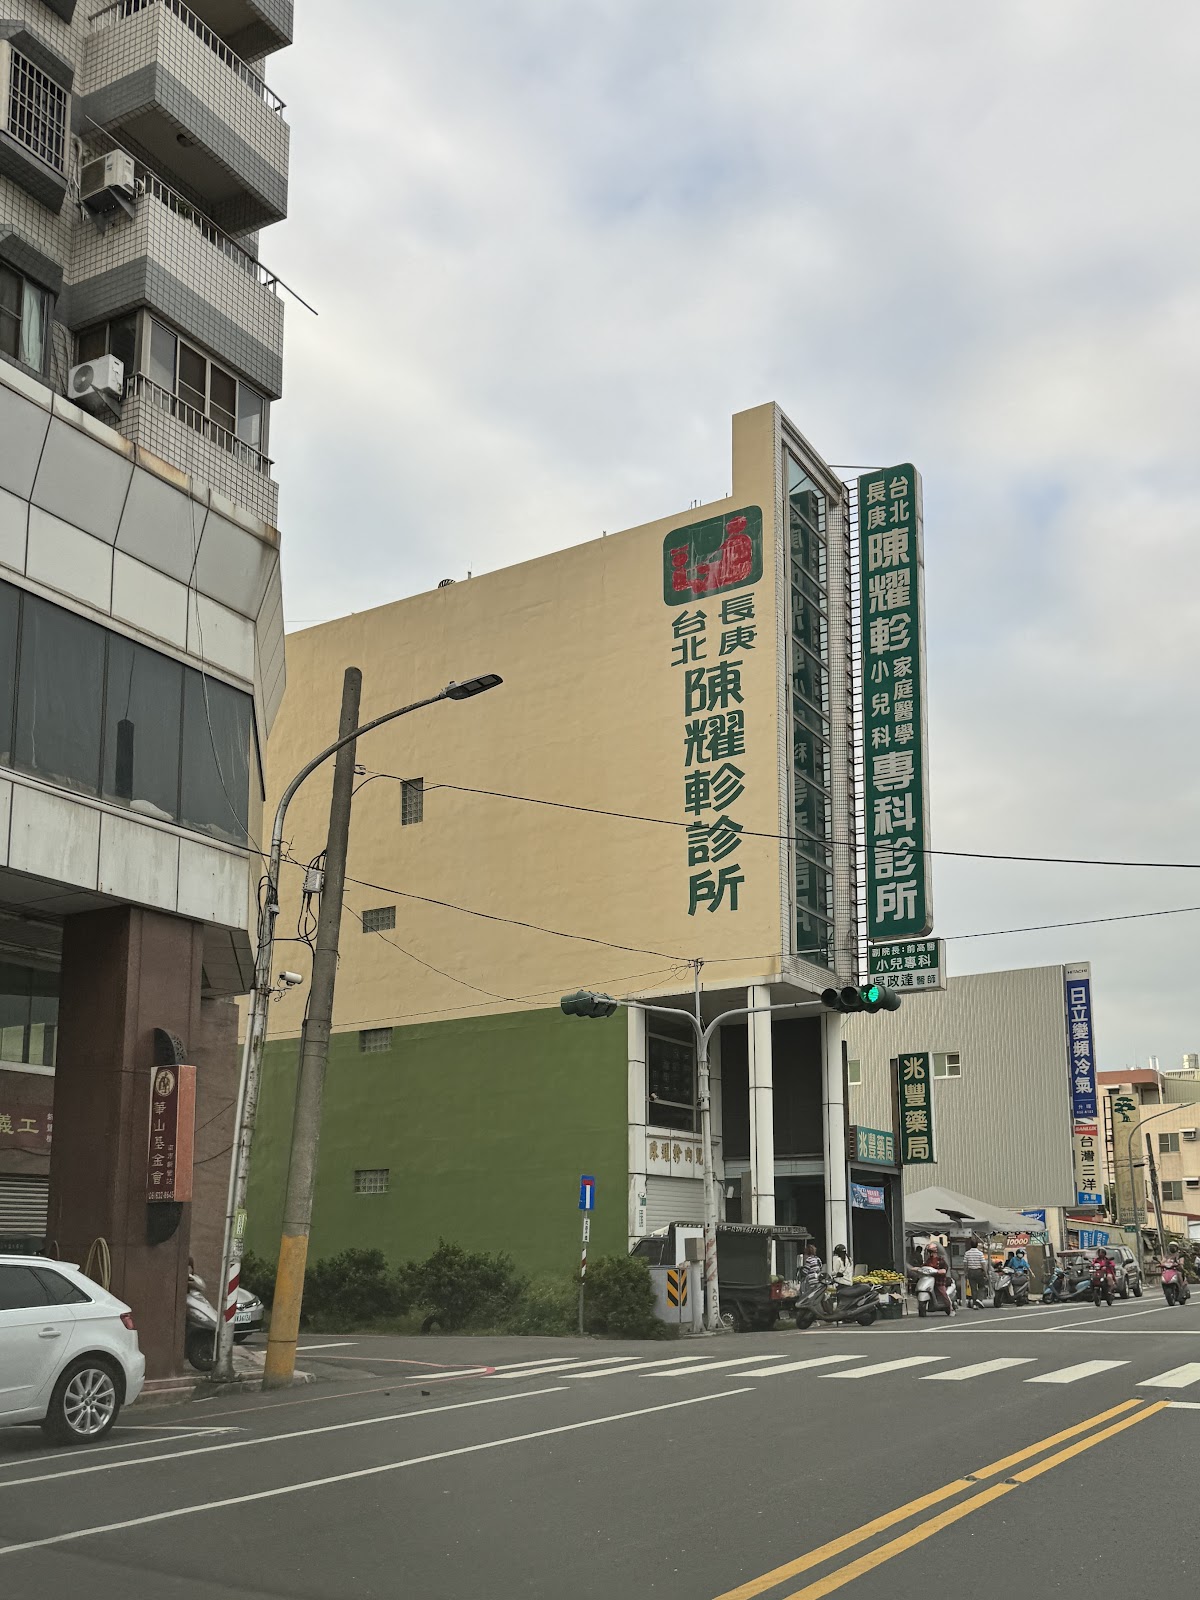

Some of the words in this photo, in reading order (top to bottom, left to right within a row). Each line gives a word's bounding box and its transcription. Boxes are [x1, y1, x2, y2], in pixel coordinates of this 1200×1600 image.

[867, 480, 887, 531] 長庚
[889, 476, 910, 523] 台北
[671, 609, 708, 668] 台北
[718, 592, 757, 655] 長庚
[870, 659, 891, 749] 小兒科
[893, 655, 914, 746] 家庭醫學
[871, 748, 918, 924] 專科診所
[876, 953, 932, 972] 小兒專科
[1070, 986, 1093, 1094] 日立變頻冷氣
[904, 1056, 930, 1160] 兆豐藥局
[151, 1101, 167, 1185] 華山基金會
[859, 1131, 895, 1161] 兆豐藥局
[1080, 1136, 1096, 1191] 台灣三洋
